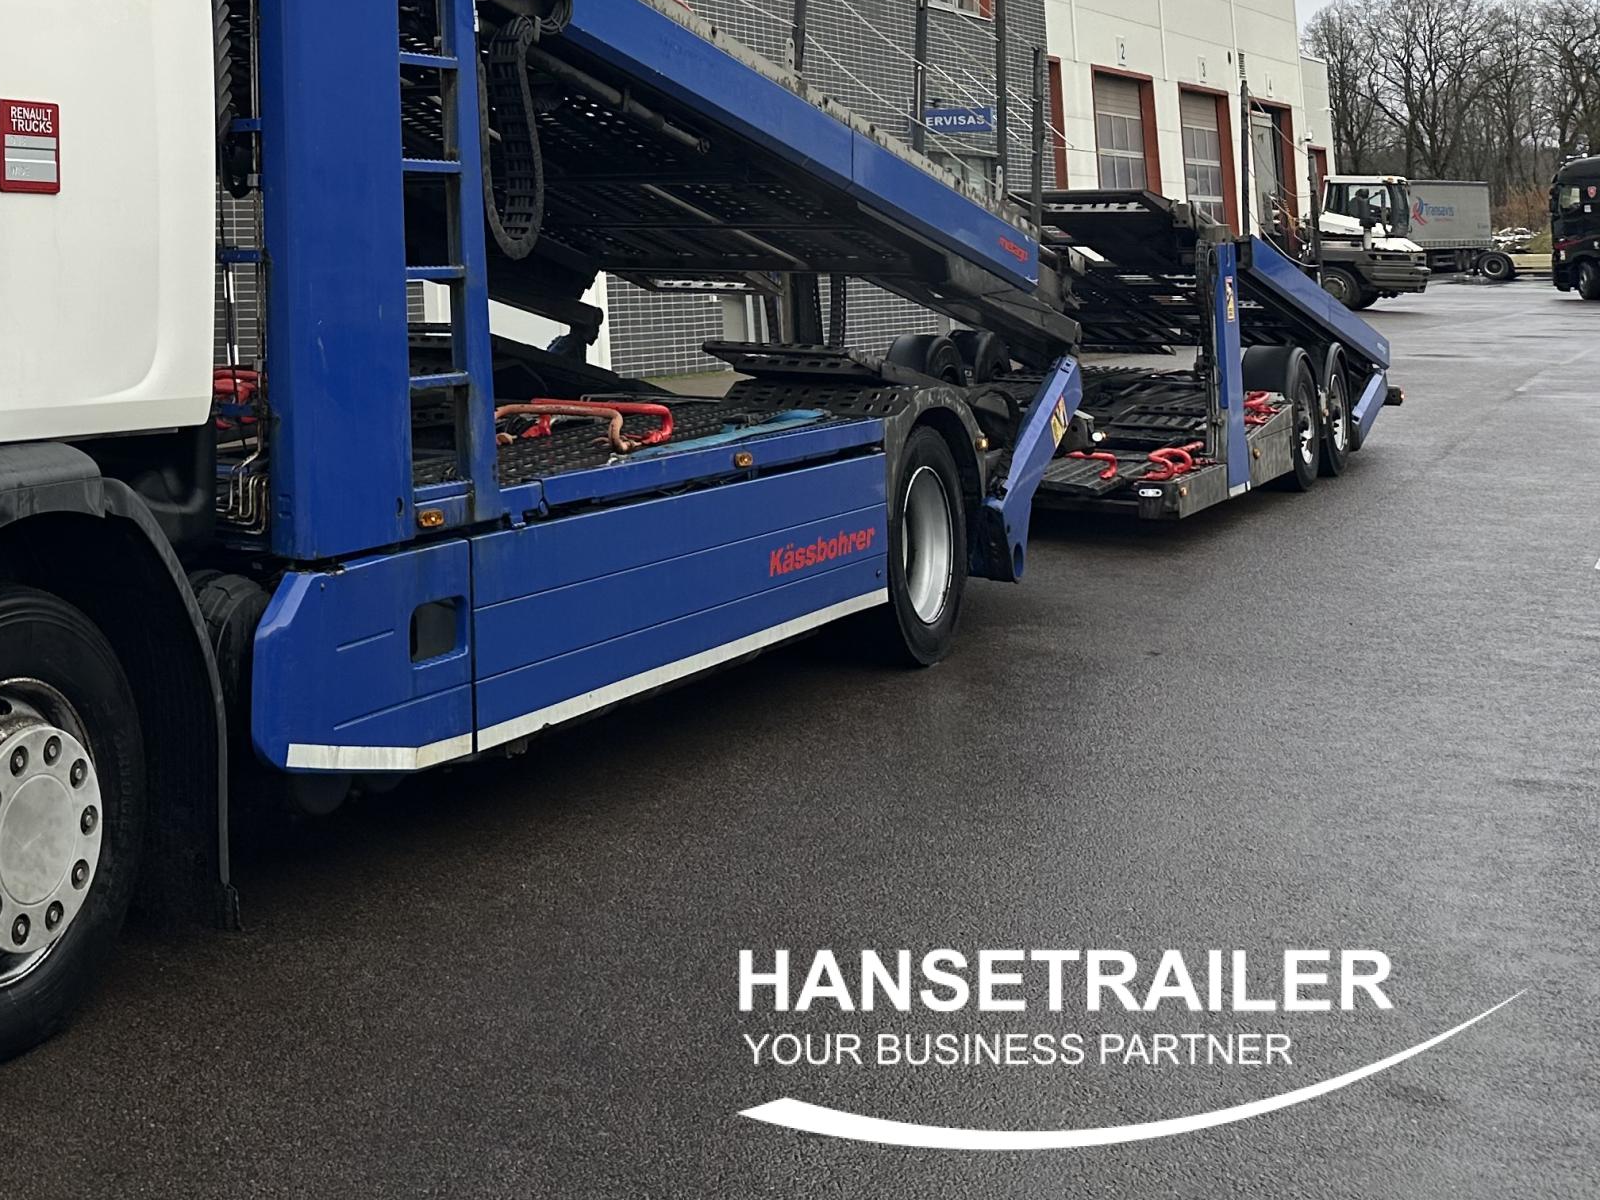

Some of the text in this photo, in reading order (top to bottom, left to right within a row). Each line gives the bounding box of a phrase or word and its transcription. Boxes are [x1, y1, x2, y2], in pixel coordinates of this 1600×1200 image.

[10, 106, 53, 121] RENAULT
[924, 115, 985, 127] ERVISAS
[10, 118, 53, 134] TRUCKS
[769, 527, 876, 577] Kässbohrer
